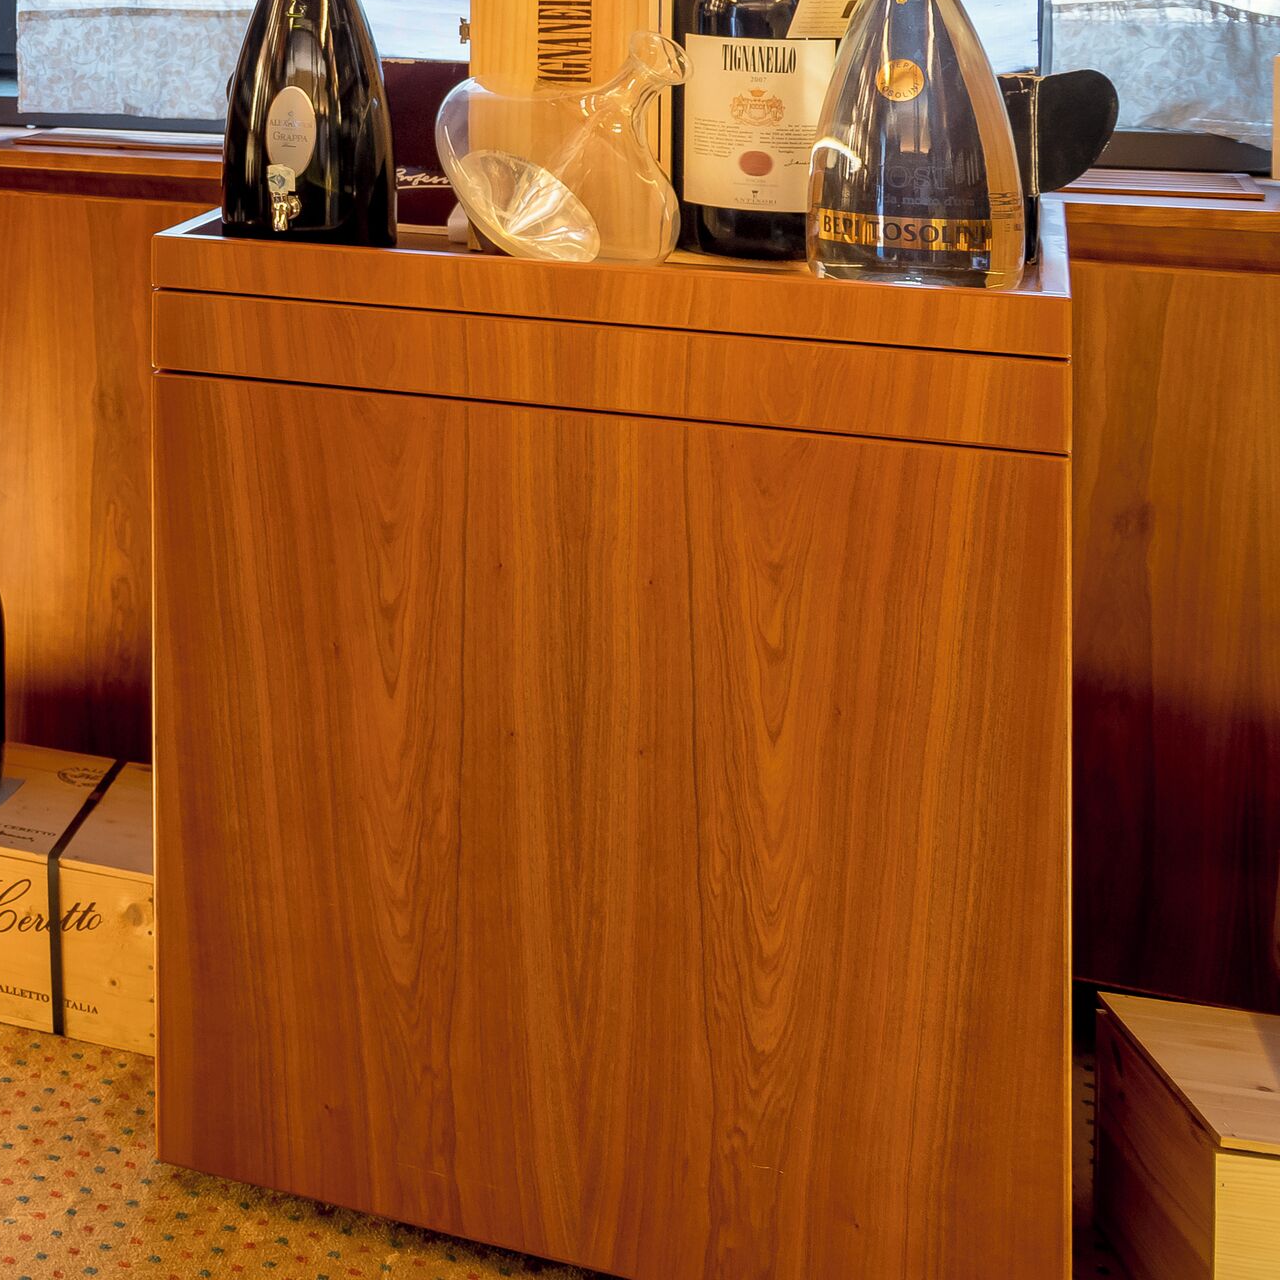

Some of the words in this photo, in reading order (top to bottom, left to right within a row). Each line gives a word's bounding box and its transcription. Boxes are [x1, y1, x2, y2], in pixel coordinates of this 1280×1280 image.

[722, 44, 797, 74] TIGNANELLO
[272, 131, 308, 144] GRAPPA
[734, 197, 777, 205] ANTINORI
[823, 214, 860, 240] BEPI
[867, 220, 991, 245] TOSOLINI
[3, 821, 57, 838] CERETTO
[62, 997, 100, 1015] TALIA
